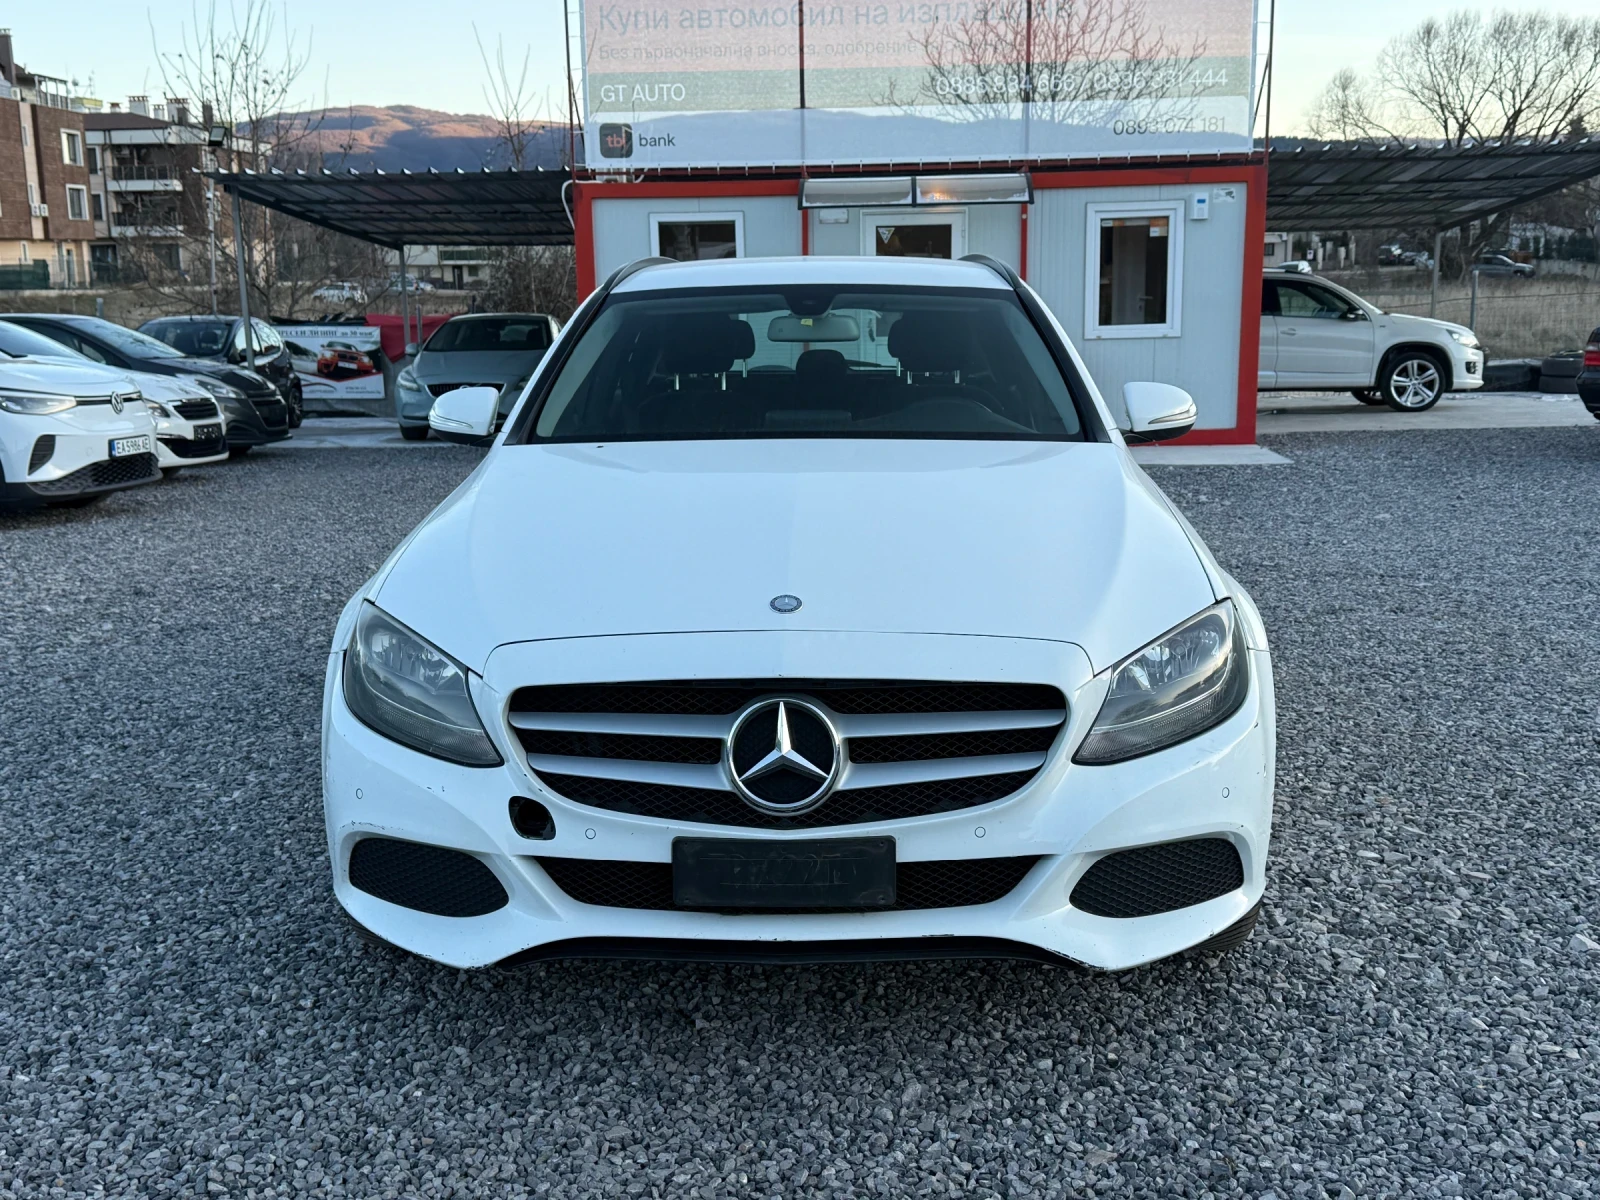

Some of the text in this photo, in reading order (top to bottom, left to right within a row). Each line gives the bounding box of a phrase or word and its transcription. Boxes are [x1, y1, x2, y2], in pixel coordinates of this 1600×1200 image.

[600, 4, 669, 36] Купи
[679, 3, 844, 29] автомобил
[855, 4, 889, 25] на
[599, 45, 629, 60] Без
[634, 45, 752, 62] първоначална
[936, 76, 988, 95] 0886
[1038, 74, 1075, 92] 666
[1188, 68, 1228, 87] 444
[601, 83, 686, 102] GT AUTO
[1113, 116, 1225, 135] 0893 074 181
[638, 133, 676, 147] bank
